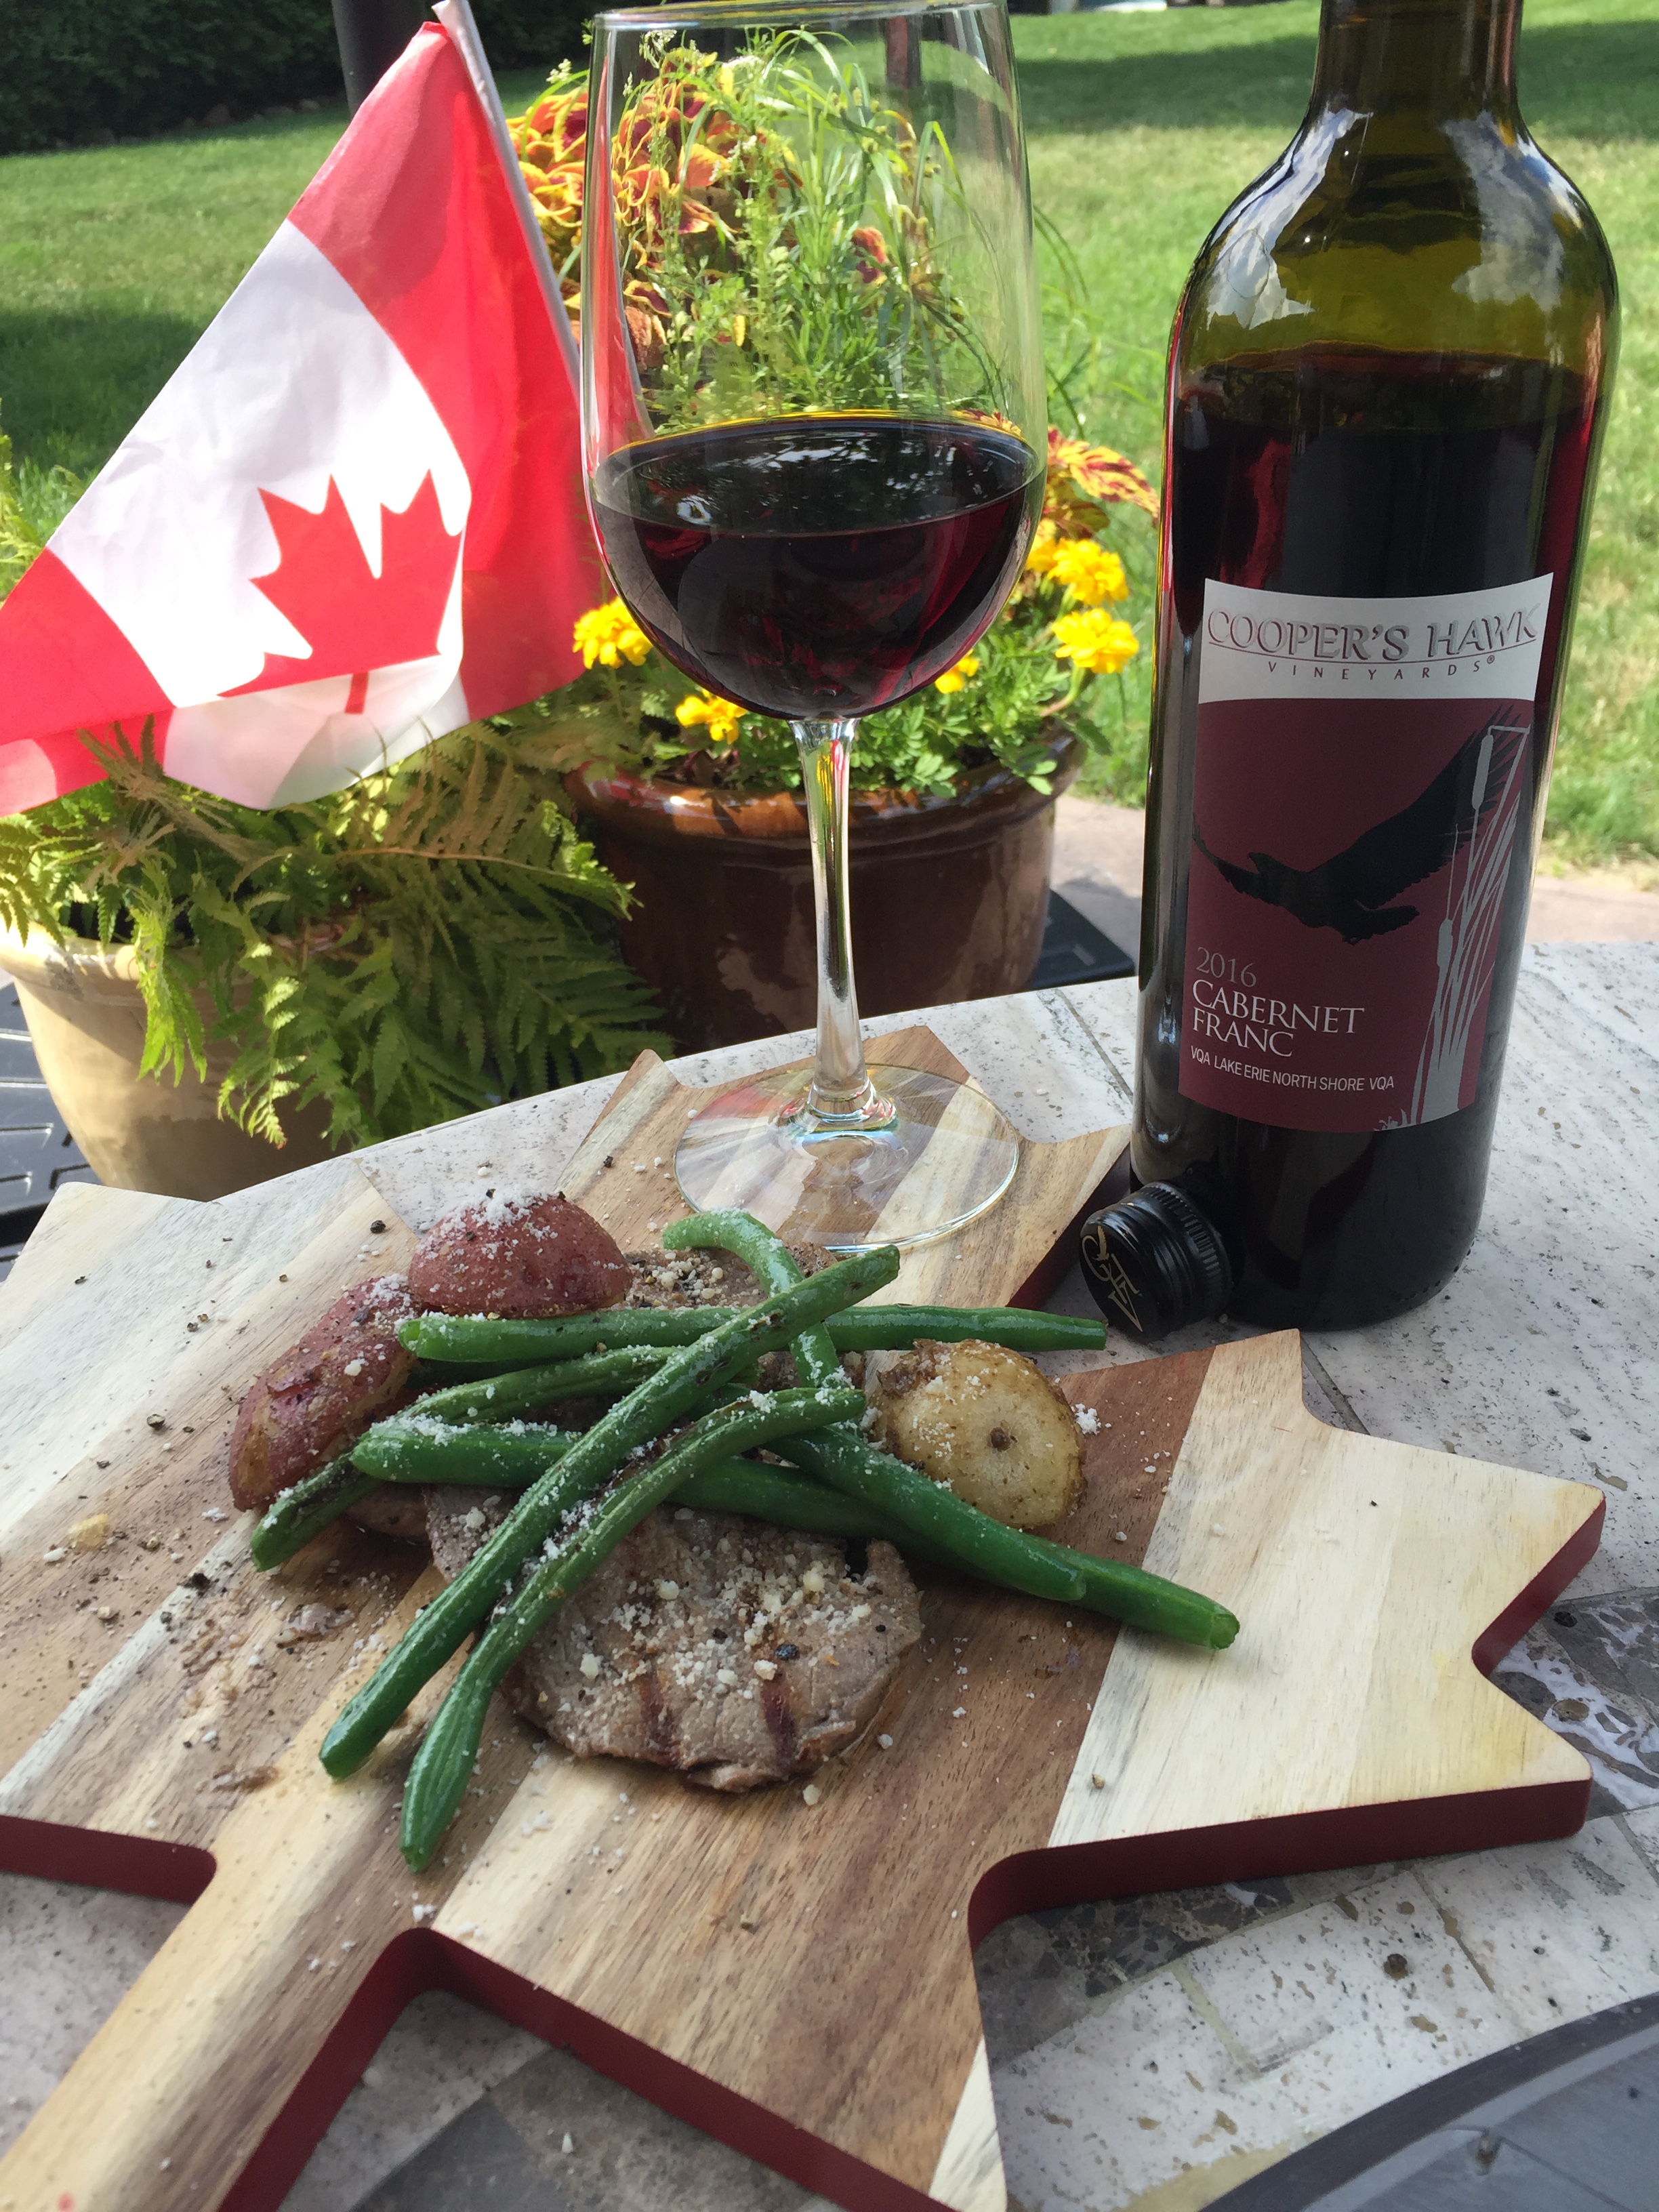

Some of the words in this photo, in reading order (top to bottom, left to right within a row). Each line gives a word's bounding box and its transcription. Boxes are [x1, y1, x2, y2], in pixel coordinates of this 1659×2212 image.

[1208, 608, 1410, 661] COOPER'S
[1427, 603, 1540, 657] HAWK
[1196, 947, 1256, 987] 2016
[1193, 979, 1364, 1033] CABERNET
[1193, 1006, 1294, 1057] FRANC
[1191, 1046, 1210, 1066] VQA
[1214, 1055, 1242, 1076] LAKE
[1244, 1065, 1270, 1083] ERIE
[1273, 1071, 1317, 1090] NORTH
[1319, 1077, 1365, 1091] SHORE
[1369, 1076, 1395, 1090] VQA
